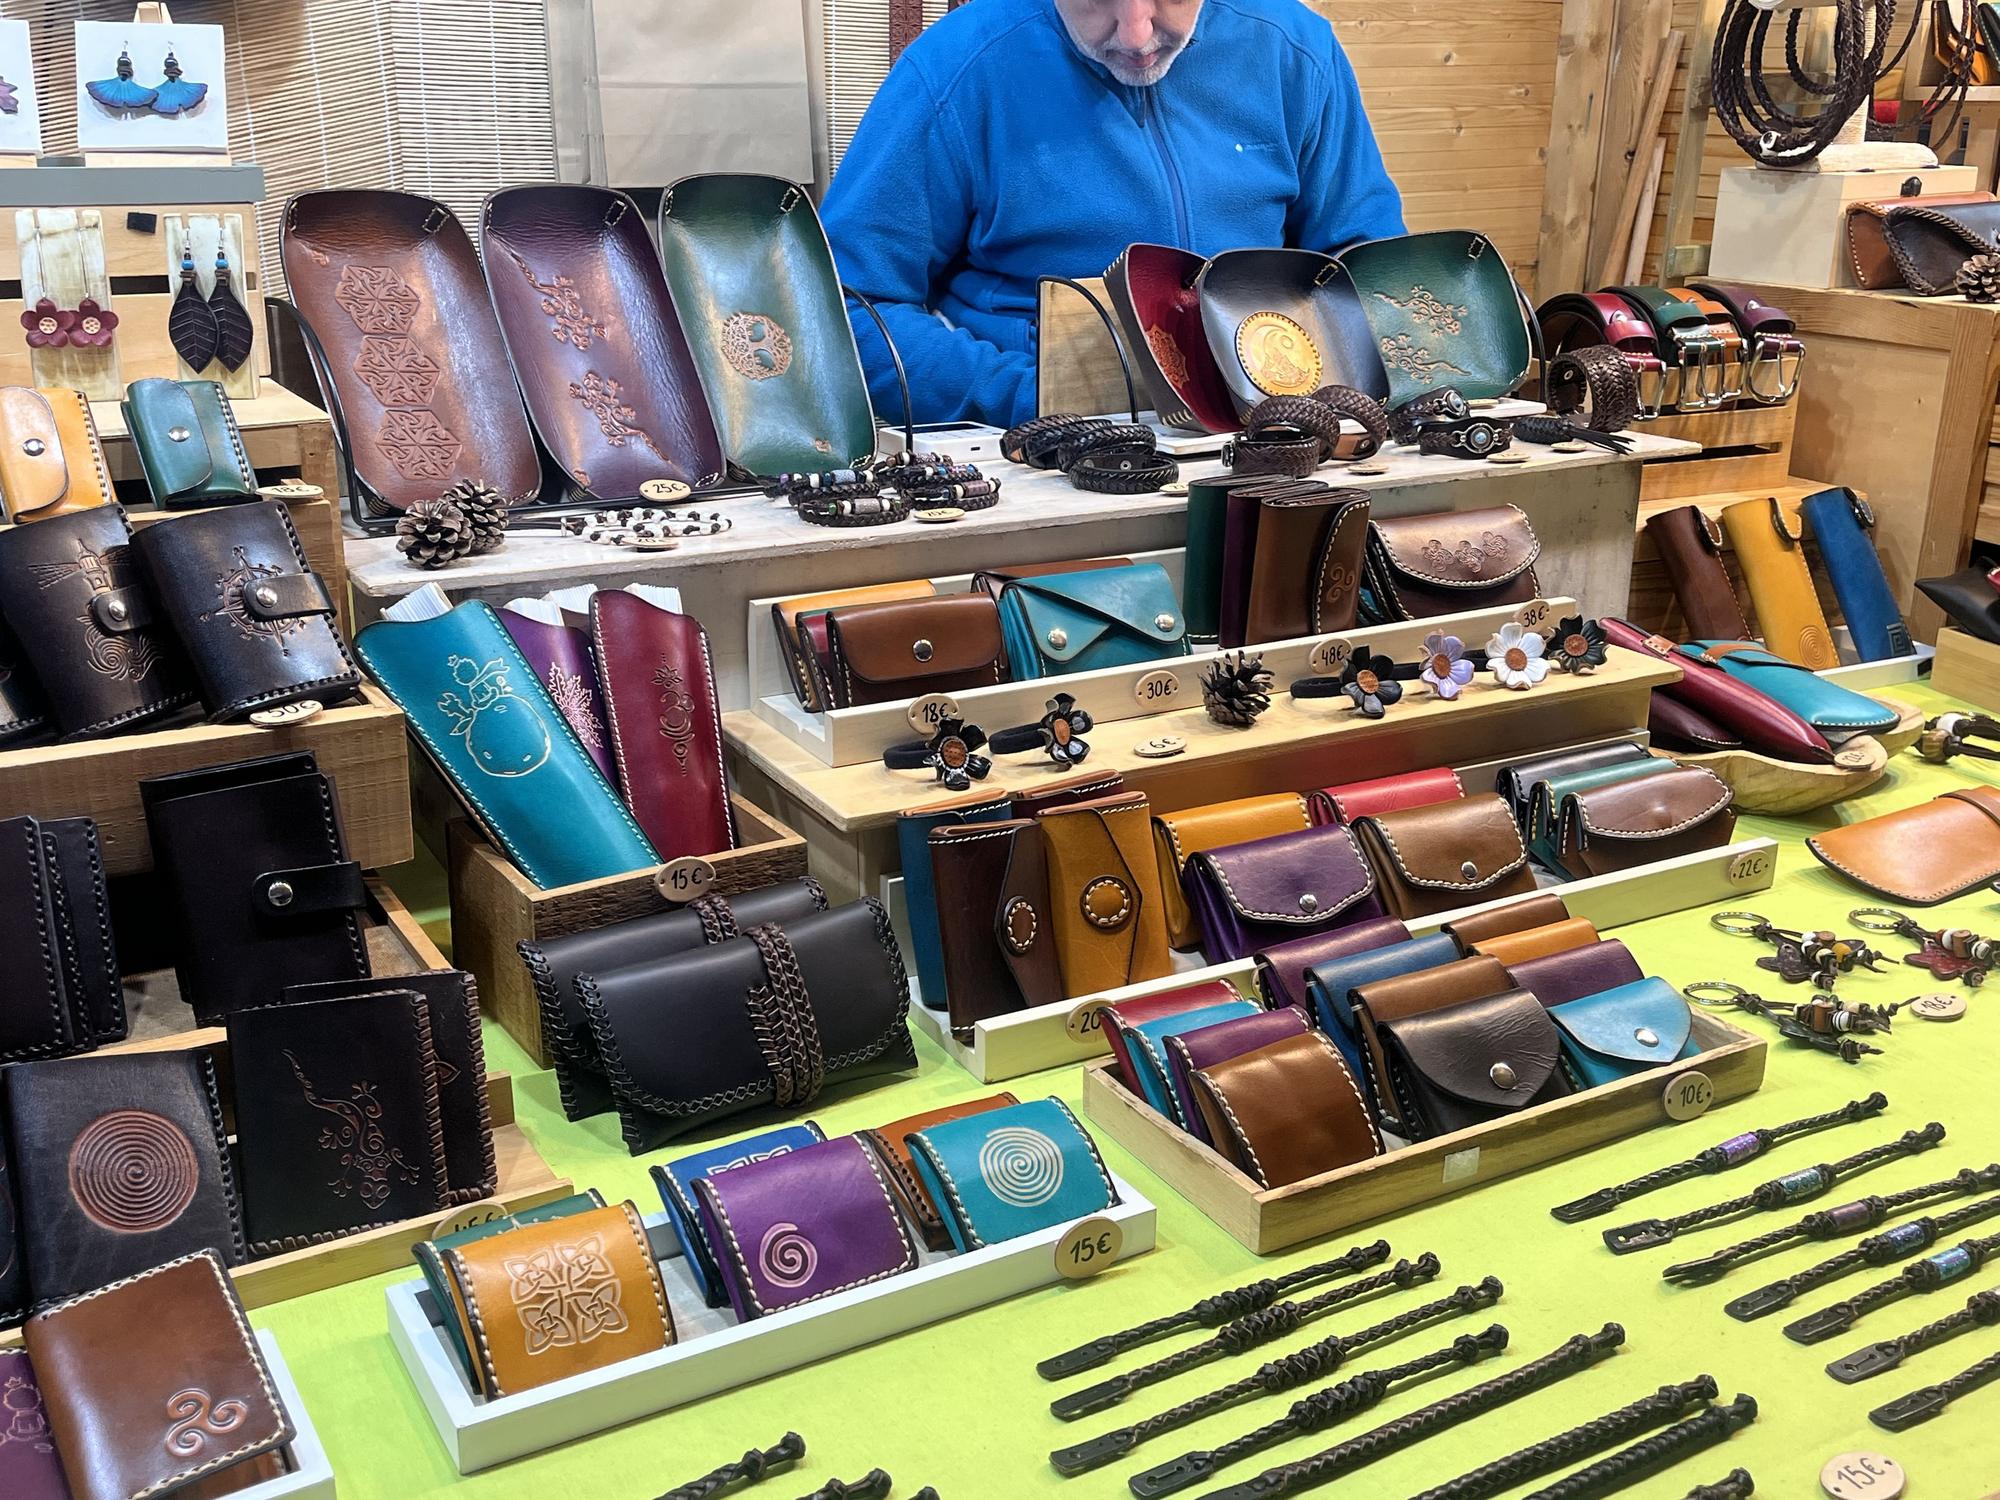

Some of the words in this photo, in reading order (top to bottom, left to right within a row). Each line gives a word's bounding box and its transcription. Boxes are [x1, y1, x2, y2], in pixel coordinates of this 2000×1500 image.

[652, 483, 683, 493] 25€
[1523, 605, 1545, 627] 38€
[1321, 644, 1344, 666] 48€
[1147, 679, 1172, 699] 30€
[268, 701, 315, 717] 50€
[922, 702, 949, 723] 18€
[1149, 738, 1176, 748] 6€
[670, 867, 703, 890] 15€
[1738, 858, 1762, 879] 22€
[1680, 1082, 1704, 1107] 10€
[1070, 1232, 1112, 1264] 15€
[1837, 1457, 1886, 1490] 15€
